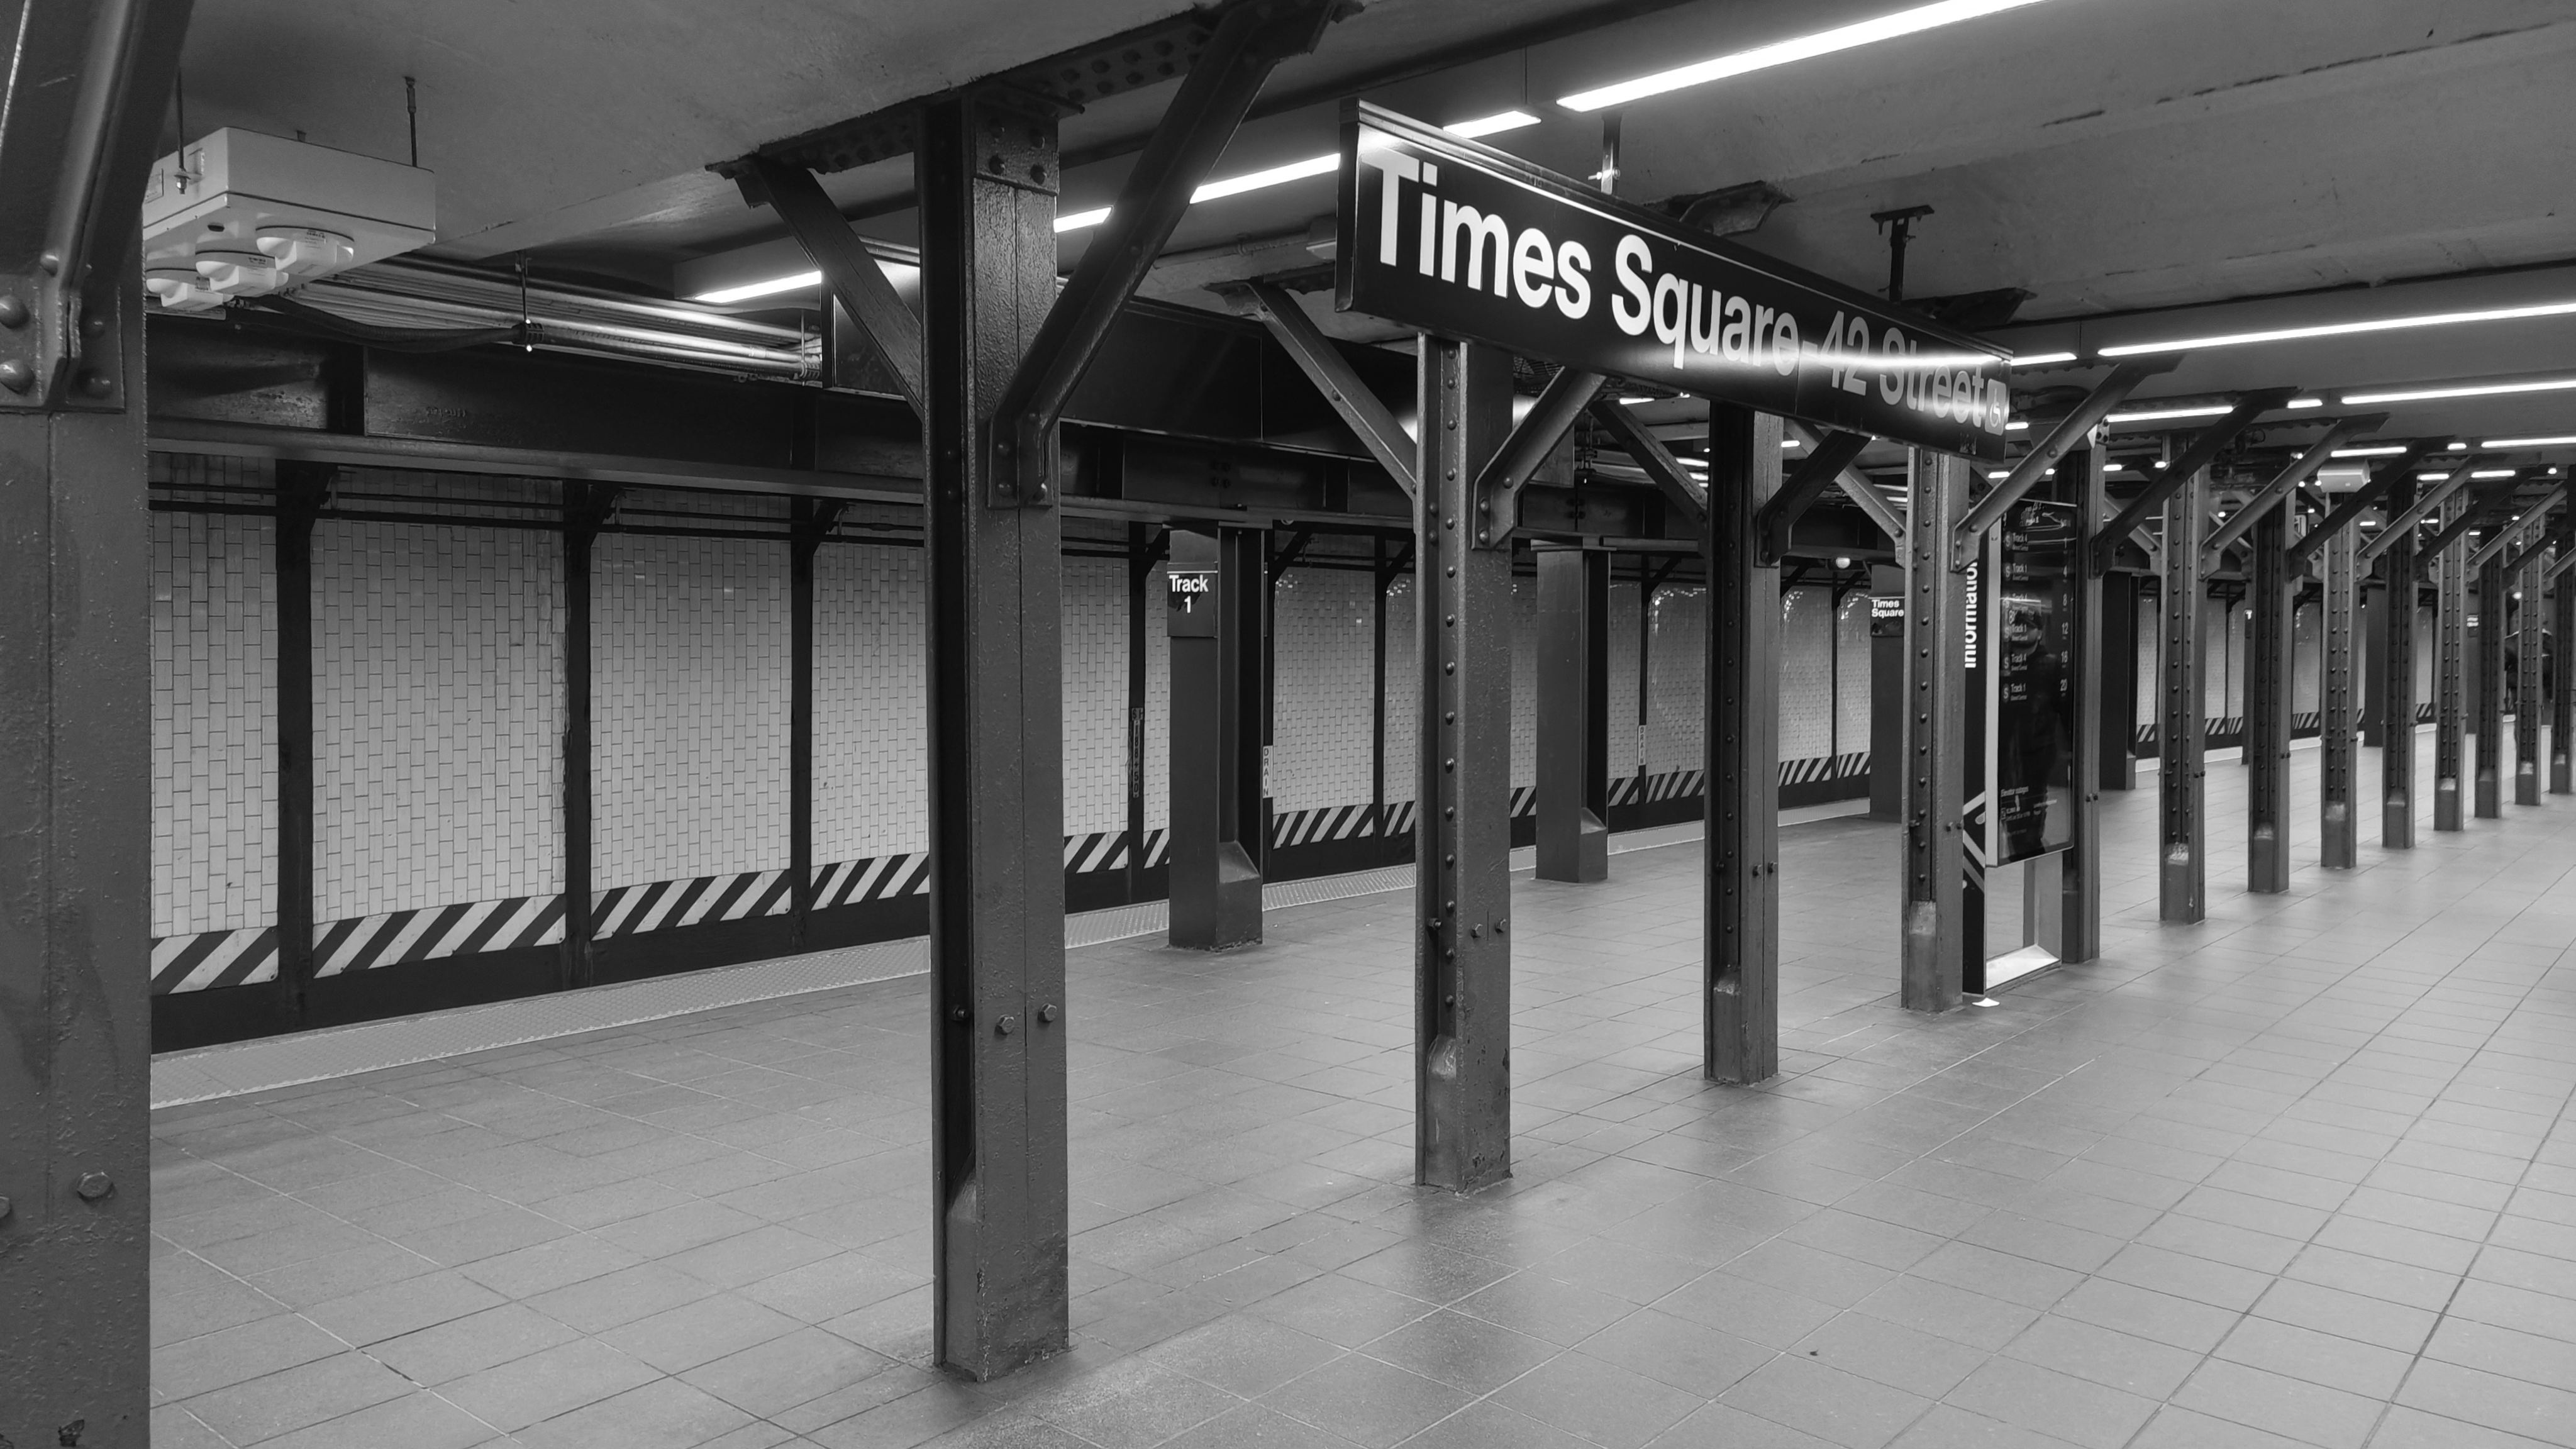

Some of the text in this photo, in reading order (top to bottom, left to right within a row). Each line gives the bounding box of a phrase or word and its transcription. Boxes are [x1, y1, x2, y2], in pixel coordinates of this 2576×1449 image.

[1359, 140, 1591, 319] Times
[1880, 328, 1984, 427] Street
[1169, 574, 1209, 592] Track
[1184, 596, 1191, 613] 1
[1872, 599, 1899, 608] Times
[1872, 608, 1904, 619] Square
[1965, 562, 1977, 669] Informatio
[2062, 622, 2068, 635] 12
[2060, 679, 2067, 691] 20
